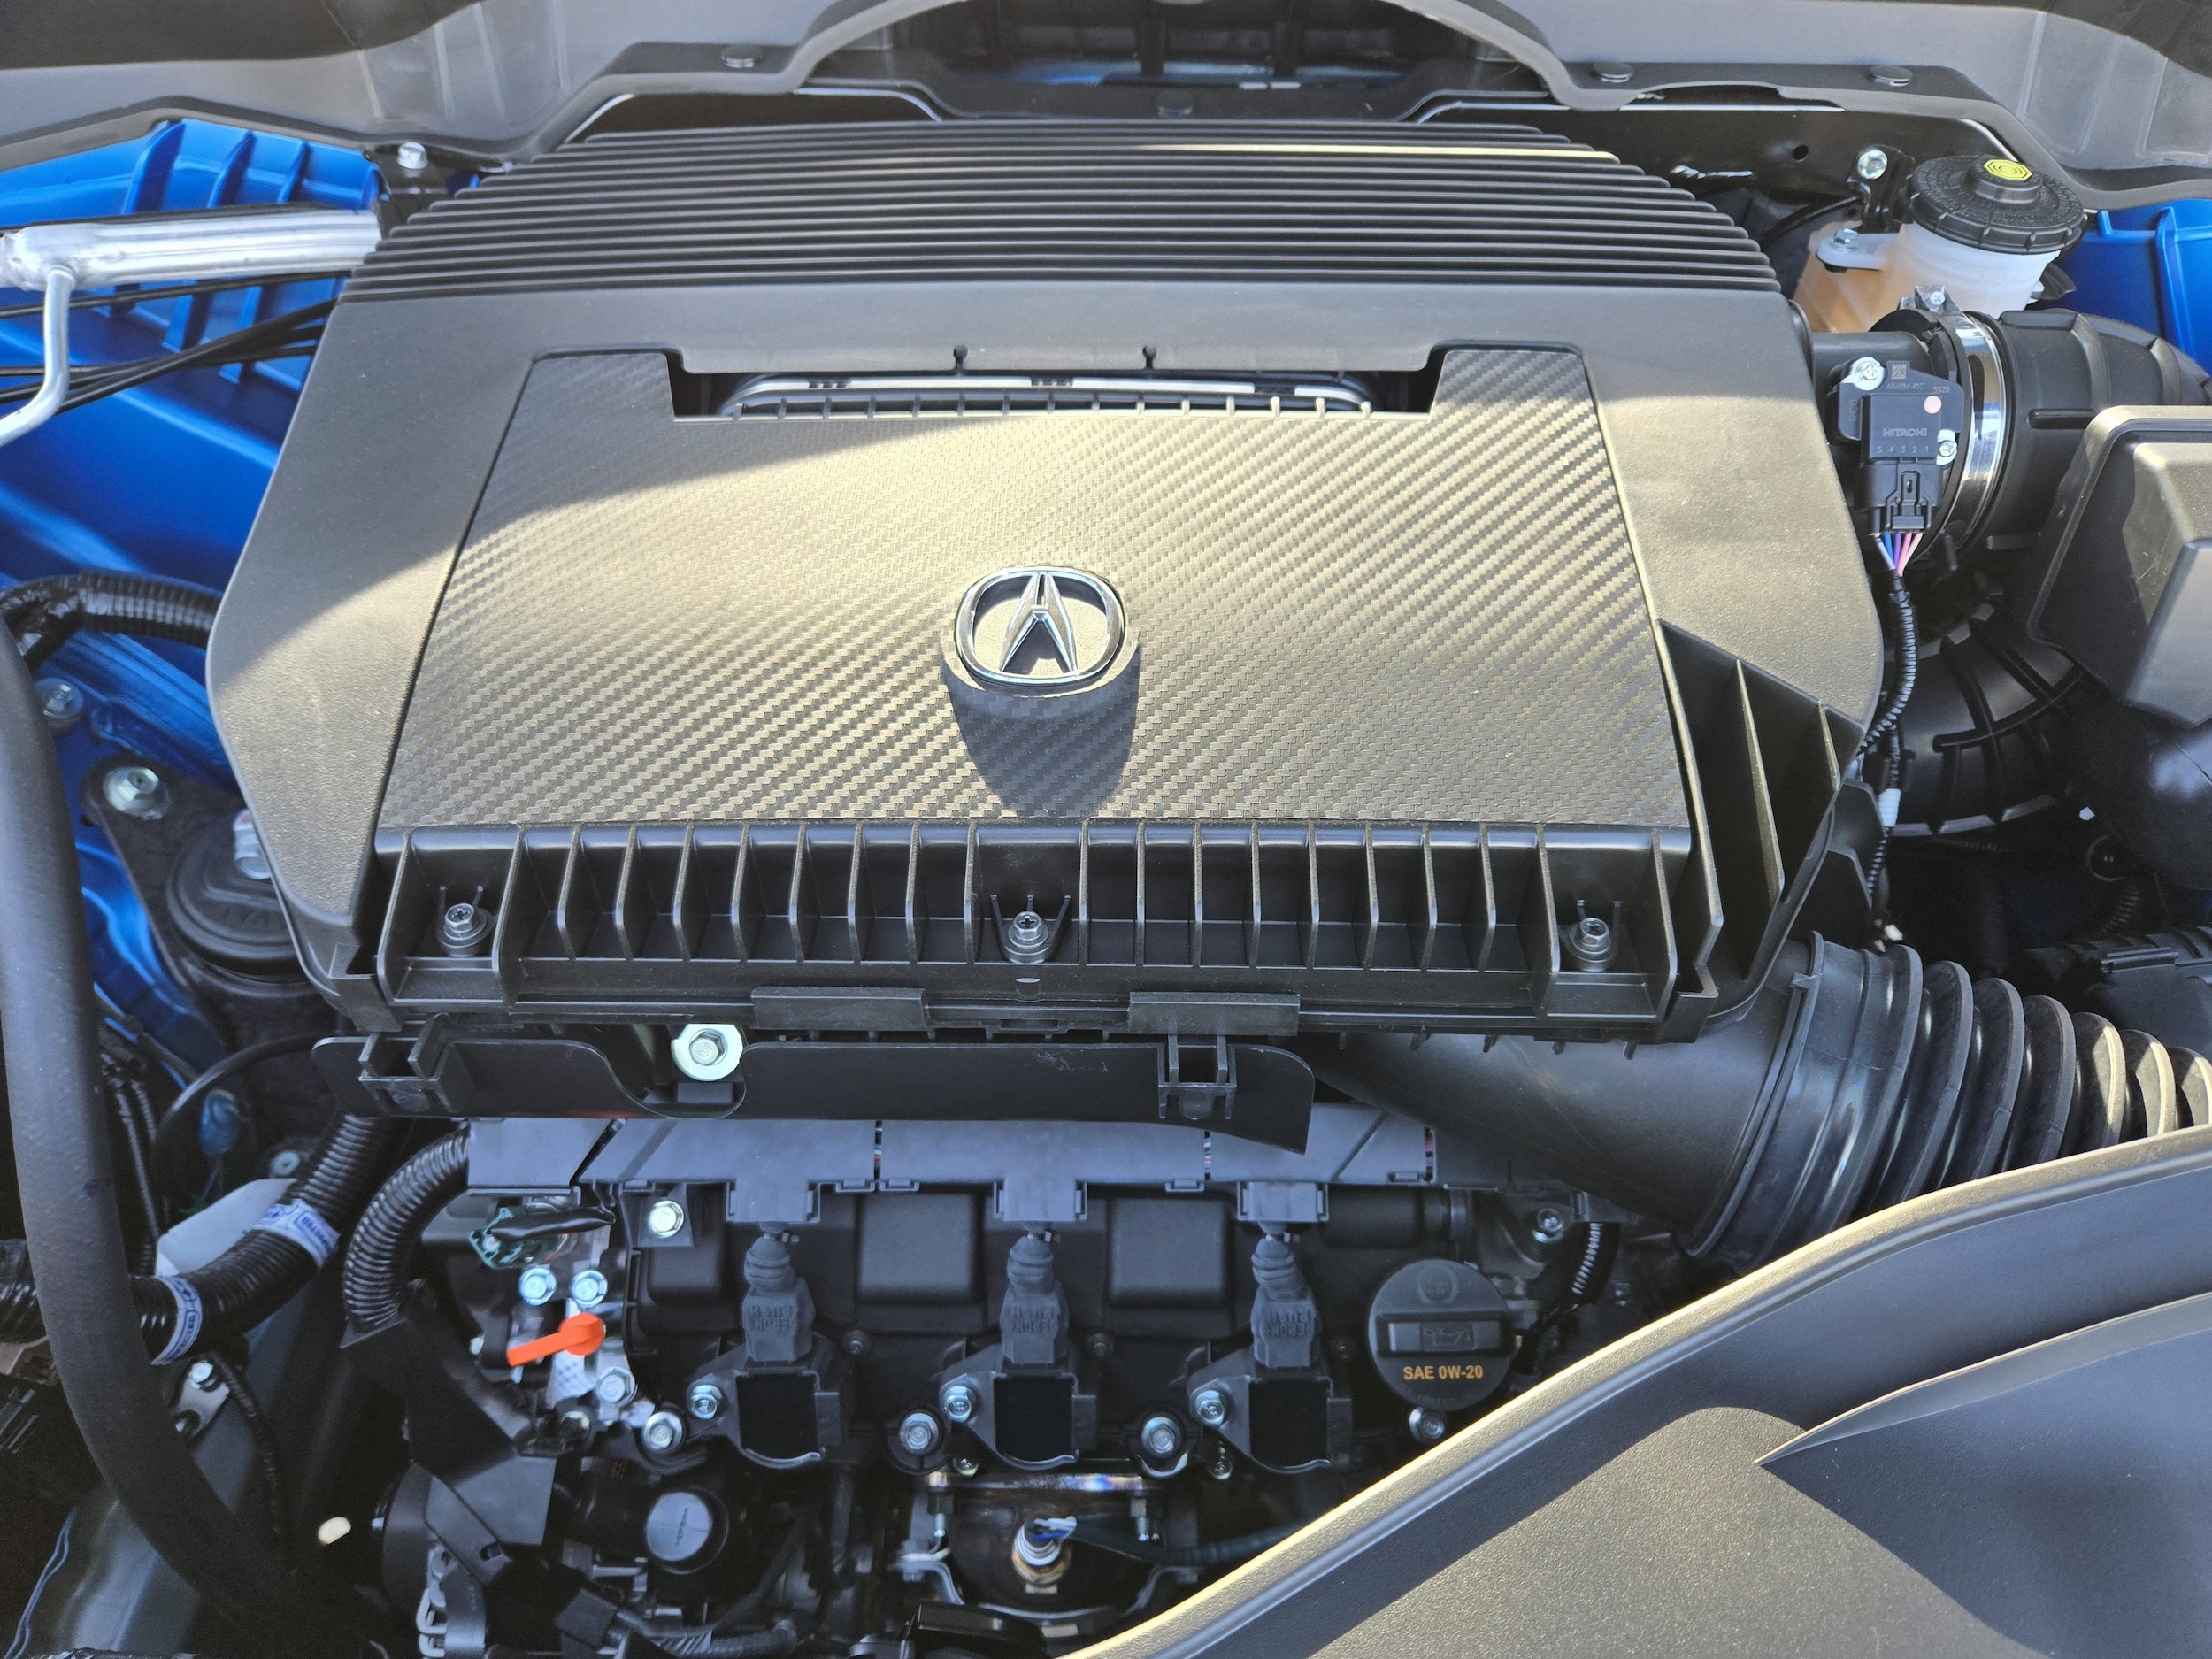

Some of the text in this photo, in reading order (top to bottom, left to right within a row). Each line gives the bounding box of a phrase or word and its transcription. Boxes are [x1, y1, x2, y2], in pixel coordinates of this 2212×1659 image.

[1932, 386, 1951, 395] 5520
[1882, 428, 1928, 438] HITACHI
[1402, 1364, 1484, 1380] SAE 0W-20
